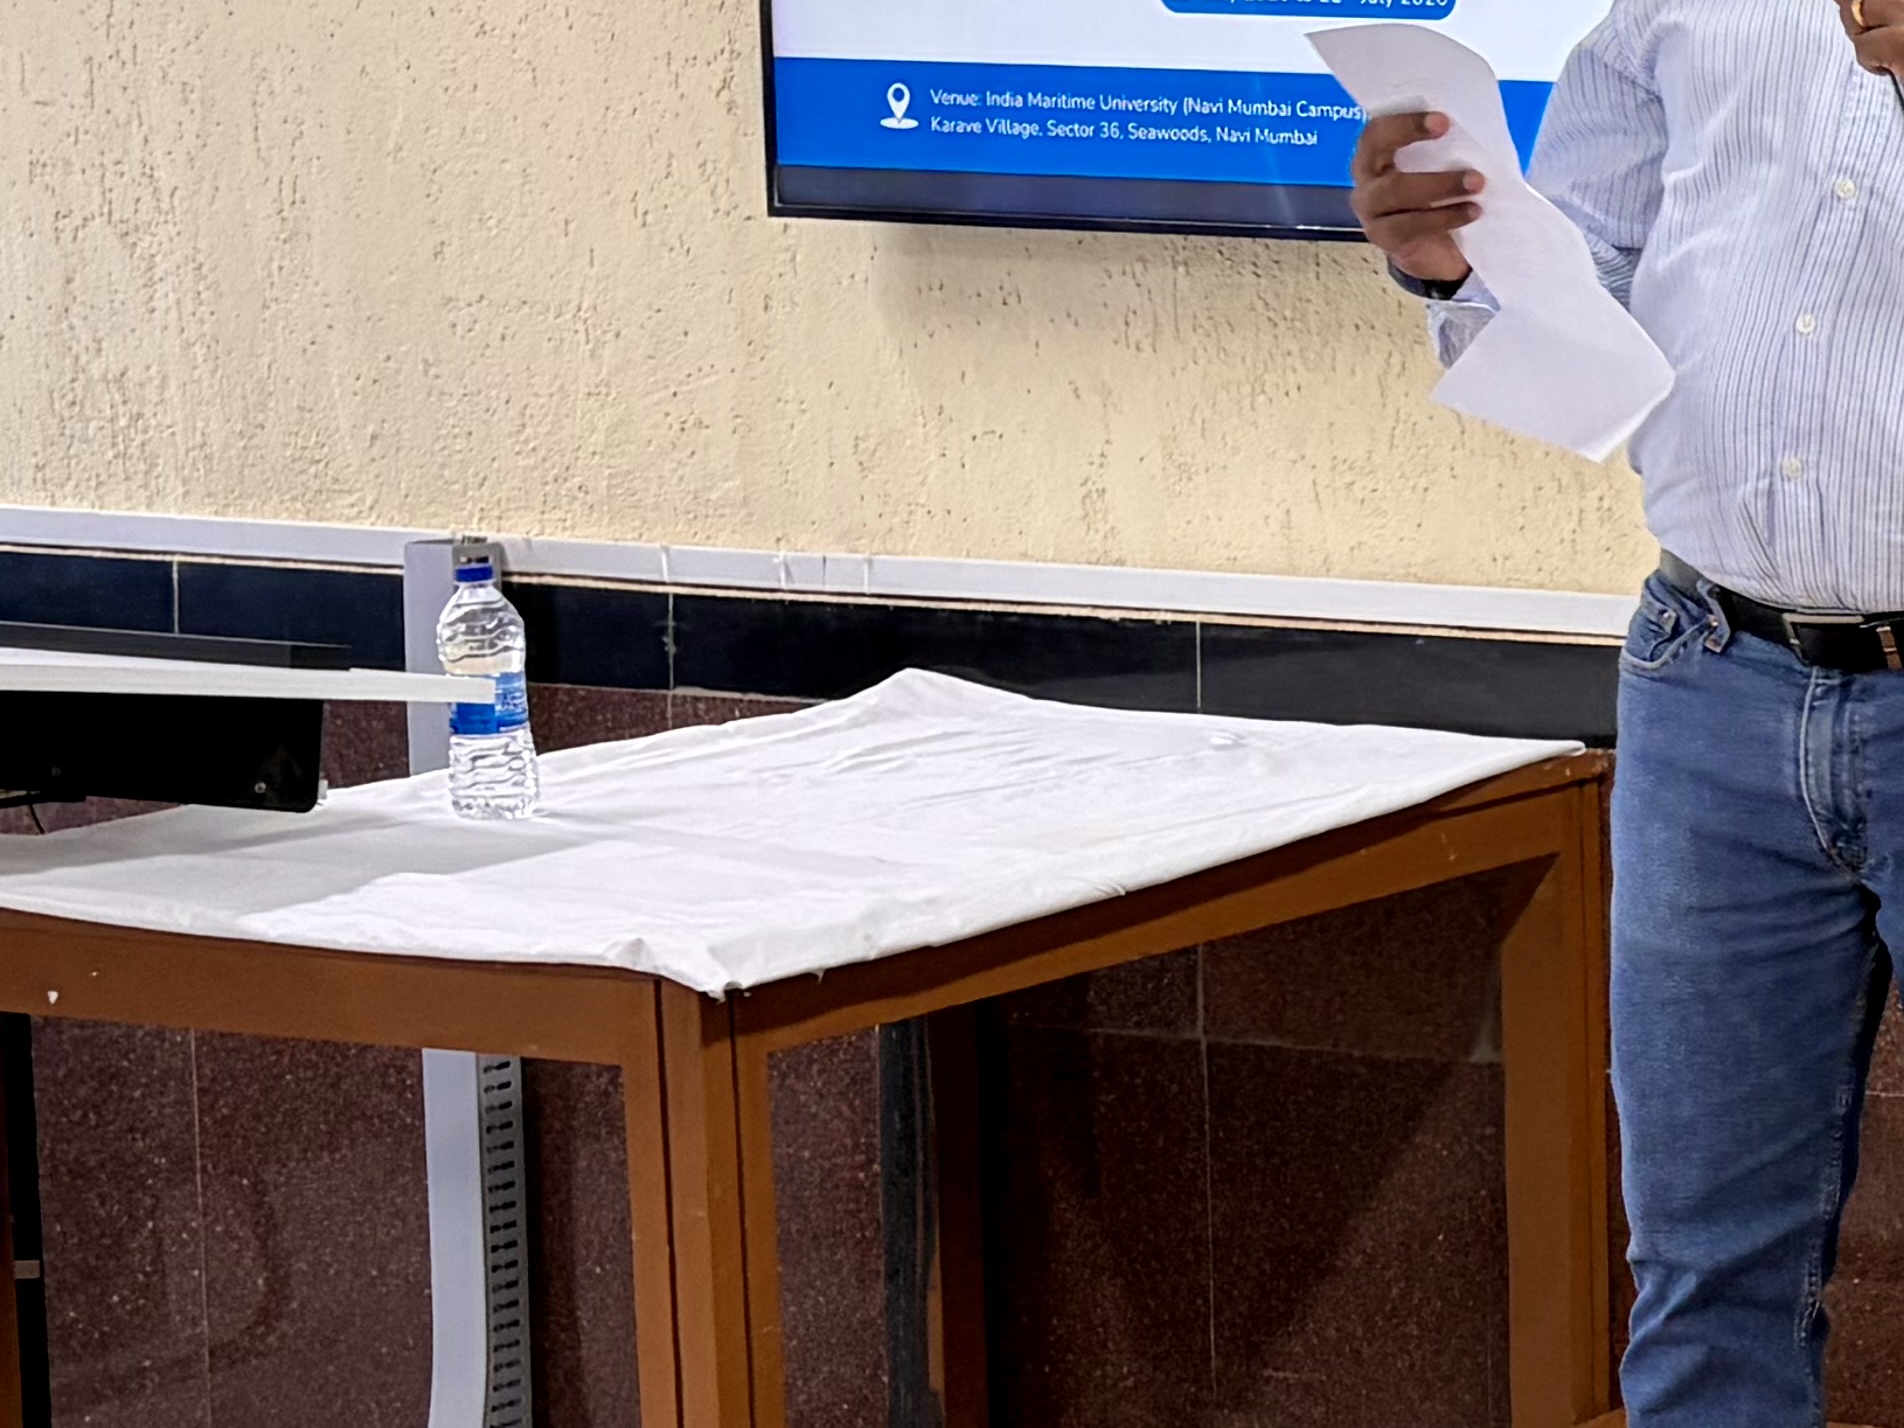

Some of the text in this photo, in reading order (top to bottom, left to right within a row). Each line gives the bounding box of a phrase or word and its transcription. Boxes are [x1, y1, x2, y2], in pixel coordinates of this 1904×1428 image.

[986, 91, 1023, 108] India
[1027, 92, 1095, 110] Maritime
[1099, 94, 1178, 115] University
[1182, 97, 1223, 116] (Navi
[1228, 99, 1291, 117] Mumbai
[931, 116, 982, 133] Karave
[1046, 119, 1095, 138] Sector
[1127, 123, 1212, 143] Seawoods,
[1216, 126, 1251, 143] Navi
[1254, 128, 1318, 145] Mumbai
